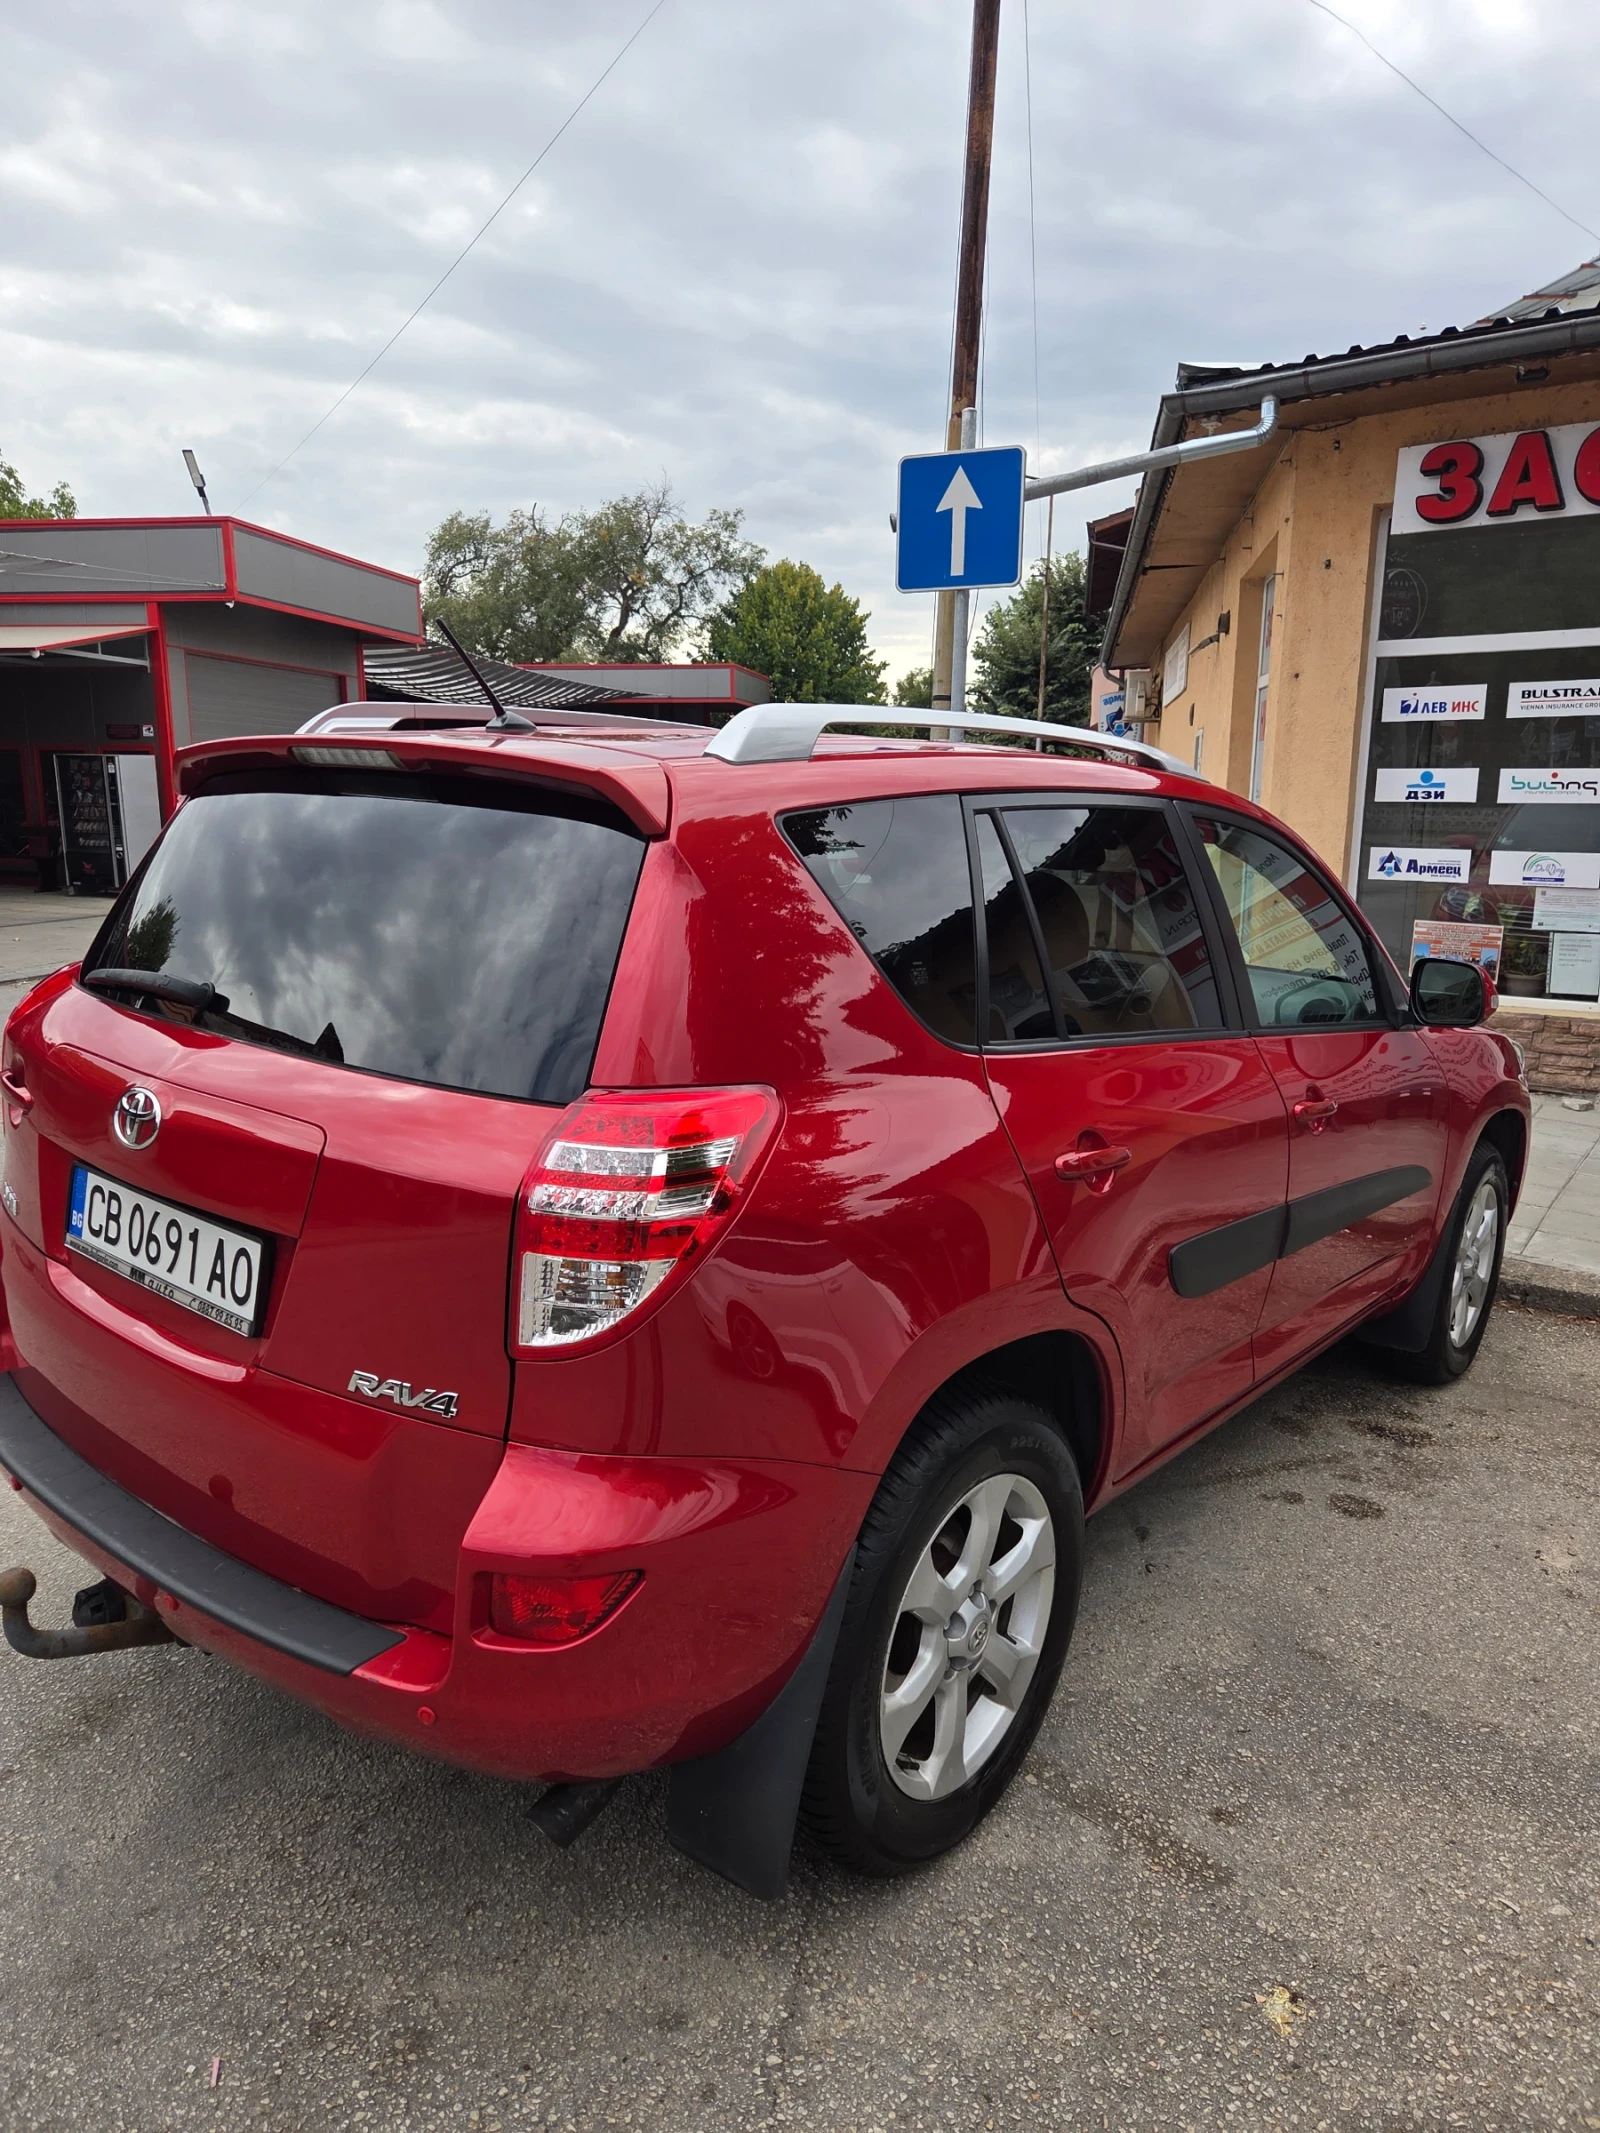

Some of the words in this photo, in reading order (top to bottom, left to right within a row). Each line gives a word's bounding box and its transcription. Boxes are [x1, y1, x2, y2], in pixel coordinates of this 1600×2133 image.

[1103, 695, 1124, 706] арм
[1521, 687, 1600, 699] BULSTRA
[1421, 701, 1447, 714] ЛЕВ
[1451, 700, 1479, 712] ИНС
[1406, 859, 1461, 877] Армеец
[72, 1209, 83, 1228] BG
[148, 1279, 174, 1298] auto
[347, 1369, 459, 1419] RAV4
